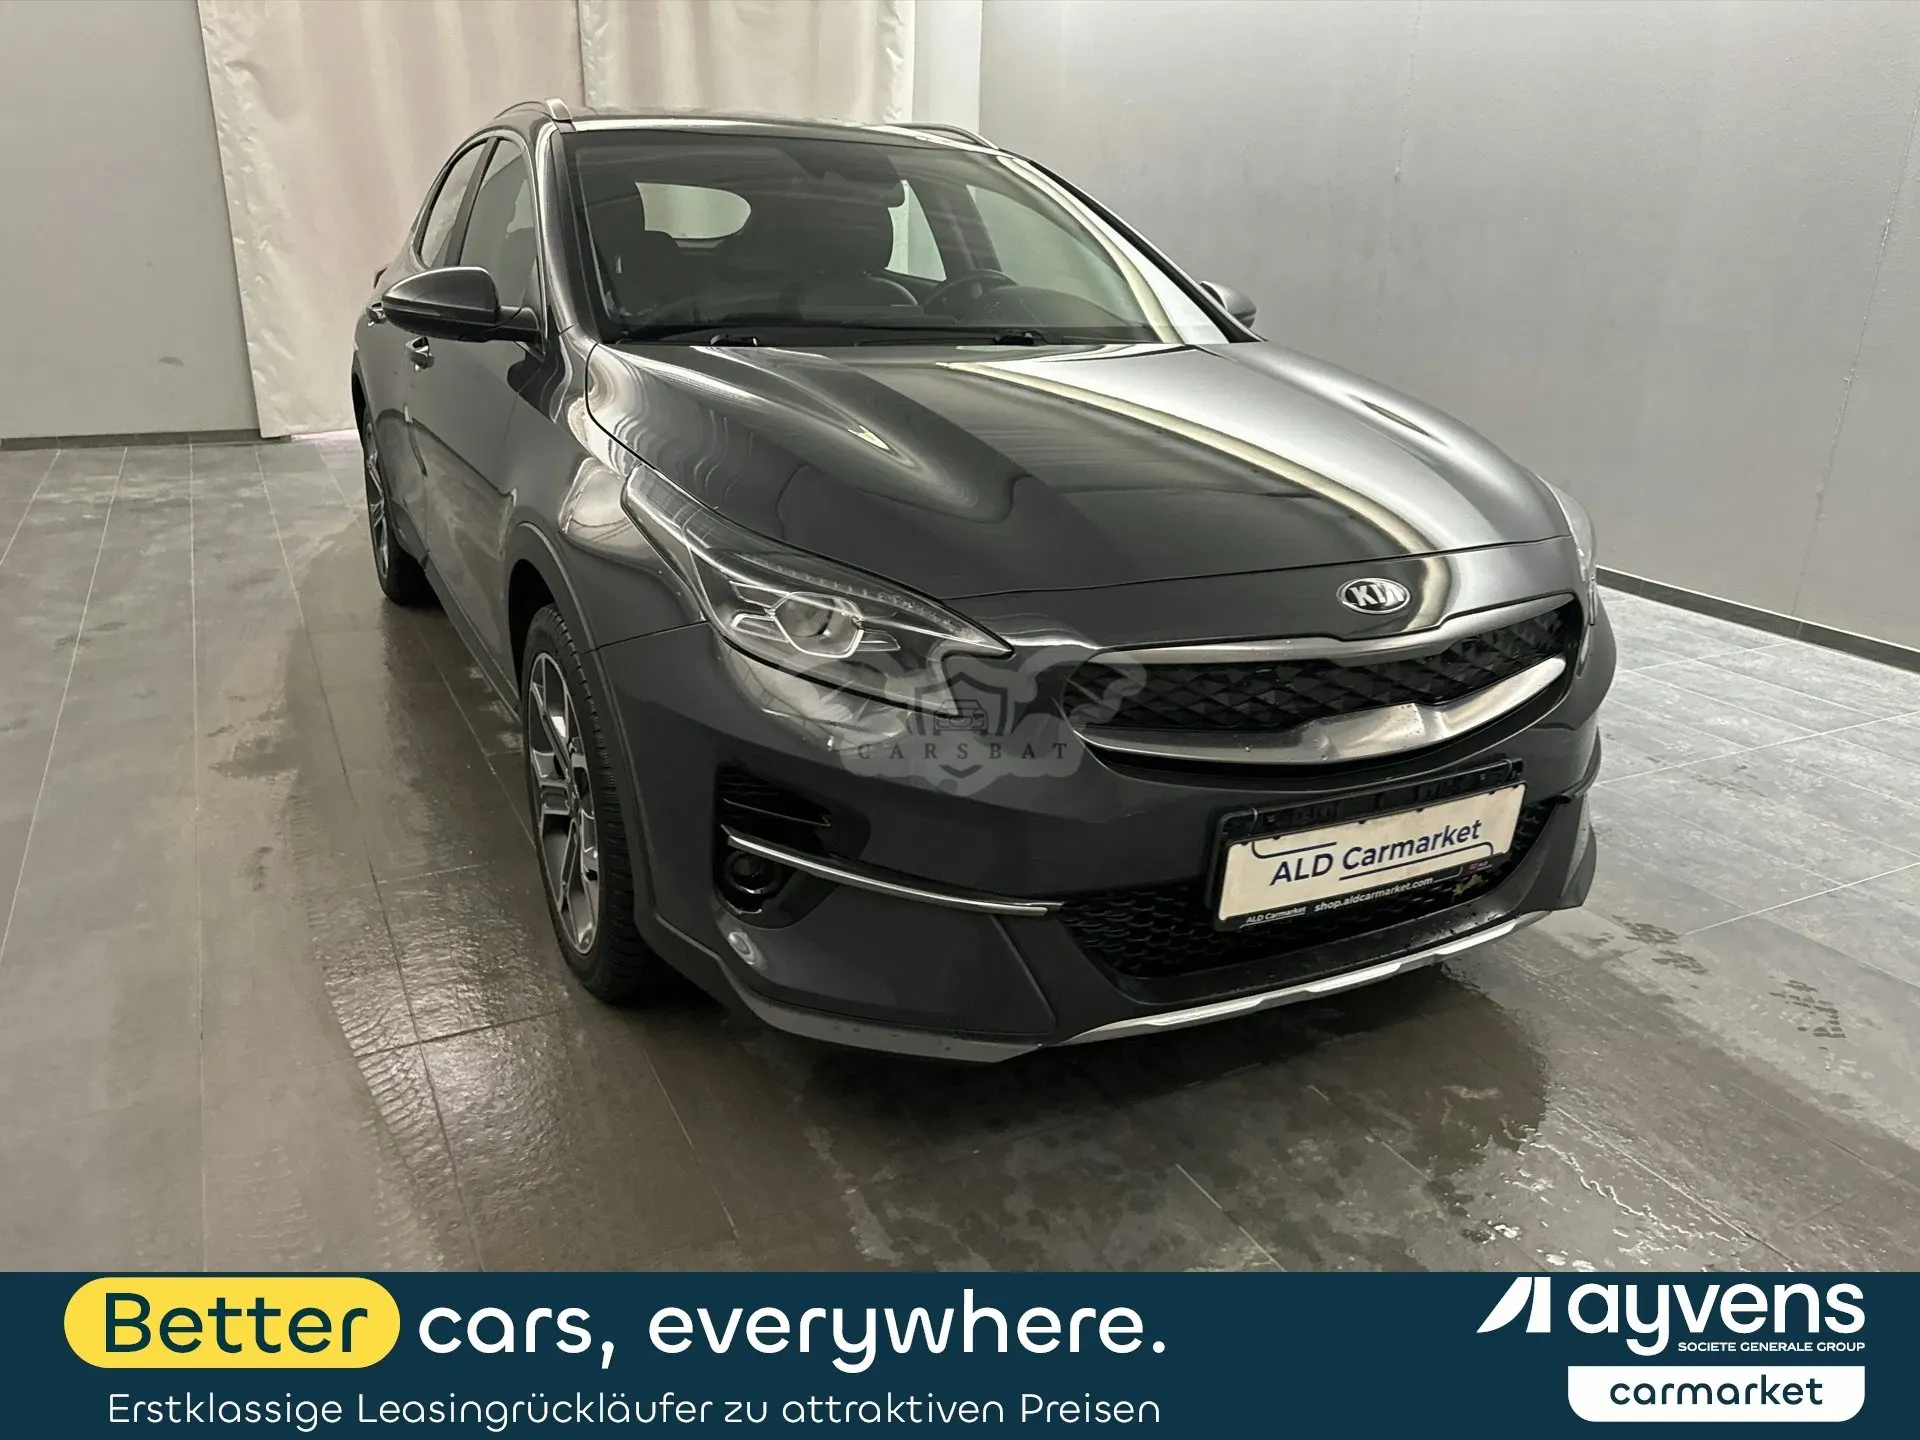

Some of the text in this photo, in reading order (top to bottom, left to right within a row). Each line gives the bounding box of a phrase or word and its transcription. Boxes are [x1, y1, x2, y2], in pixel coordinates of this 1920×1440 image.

[1349, 584, 1405, 607] KIA
[1269, 819, 1482, 886] ALD Carmarket
[1313, 876, 1434, 913] shop.aldcarmarket.com
[1245, 905, 1307, 924] ALD Carmarket
